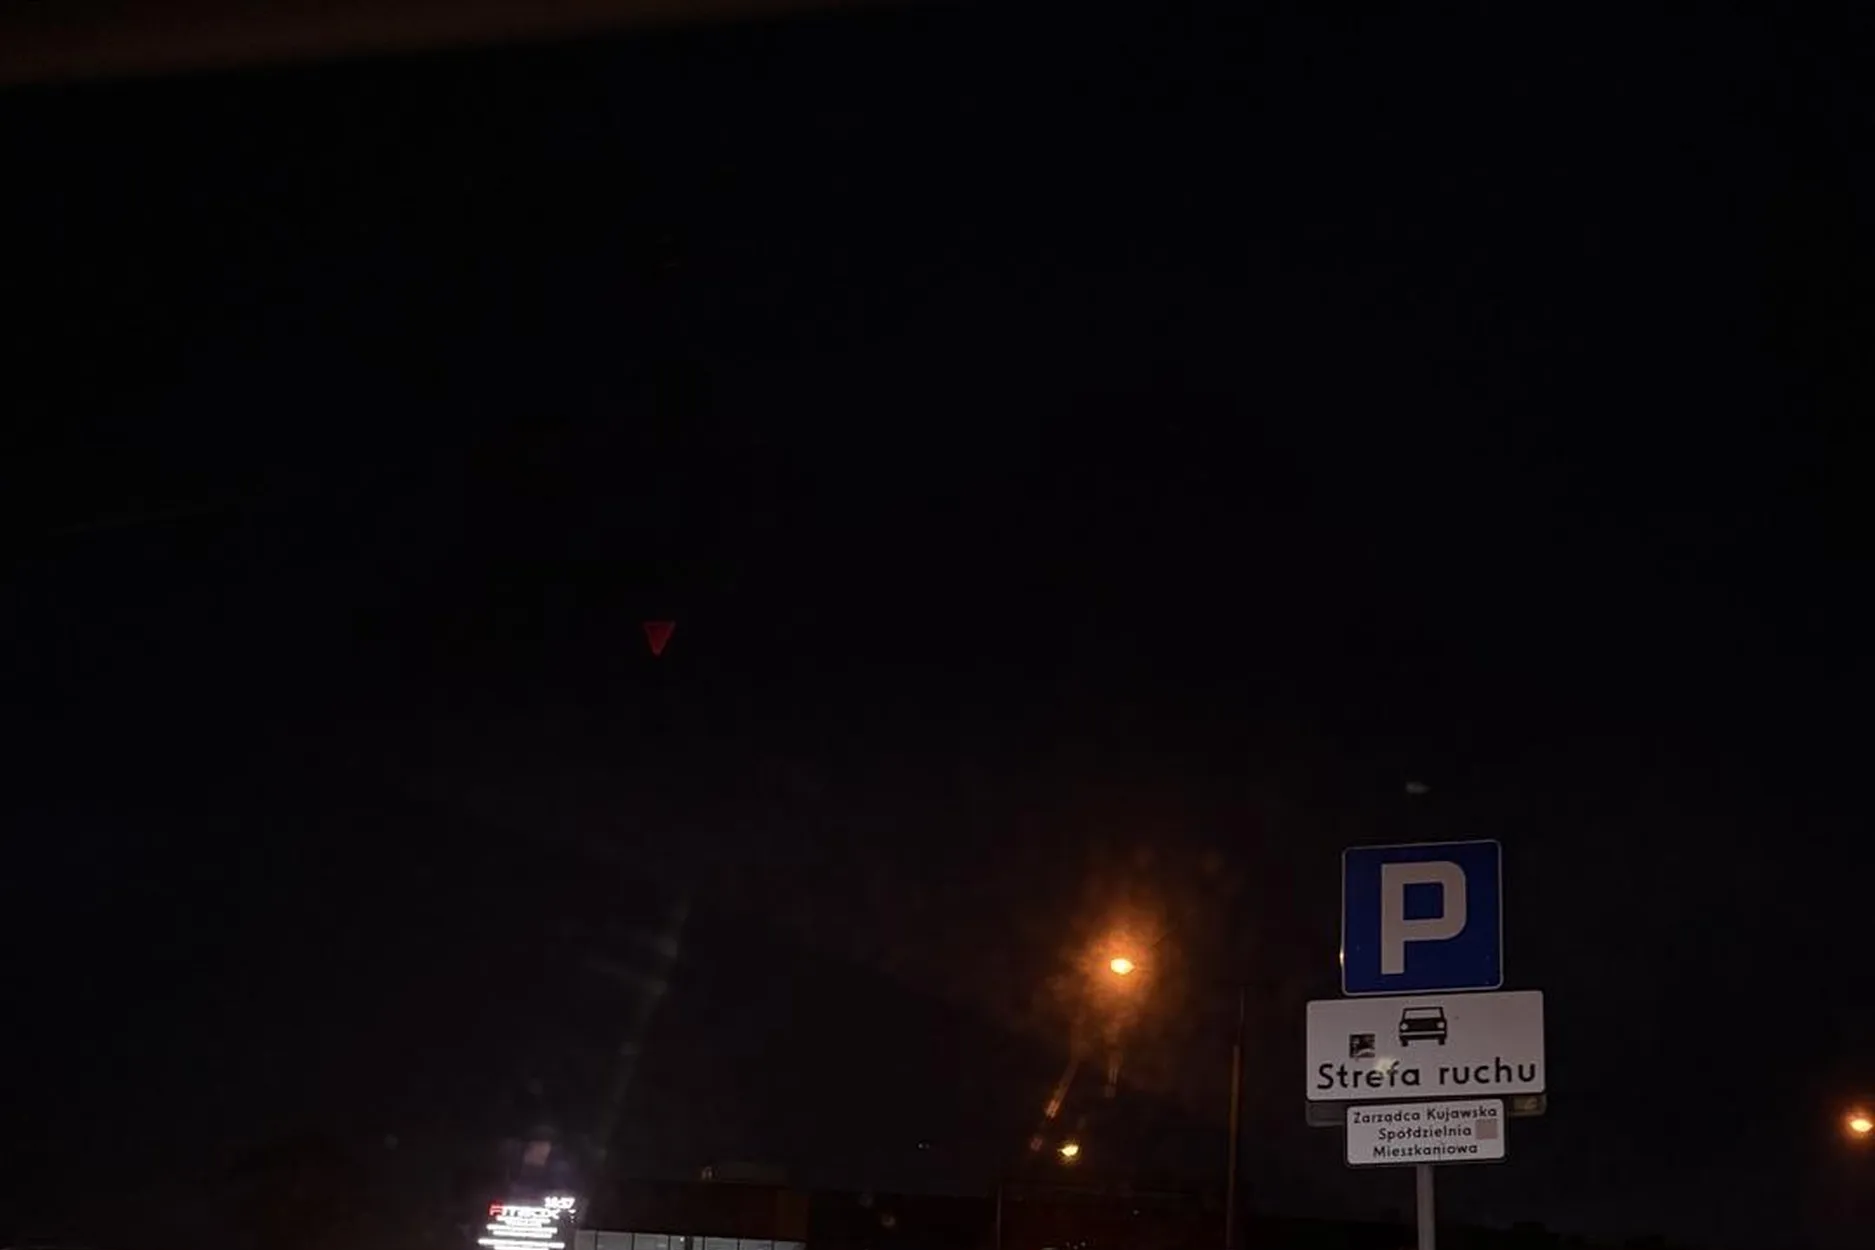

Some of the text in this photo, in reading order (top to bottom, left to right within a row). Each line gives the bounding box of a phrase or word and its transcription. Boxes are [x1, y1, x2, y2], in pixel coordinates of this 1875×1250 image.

[1381, 861, 1467, 975] P
[1317, 1057, 1537, 1090] Strefa ruchu
[1353, 1106, 1497, 1126] Zarządca Kujawska
[1373, 1143, 1478, 1158] Mieszkaniowa
